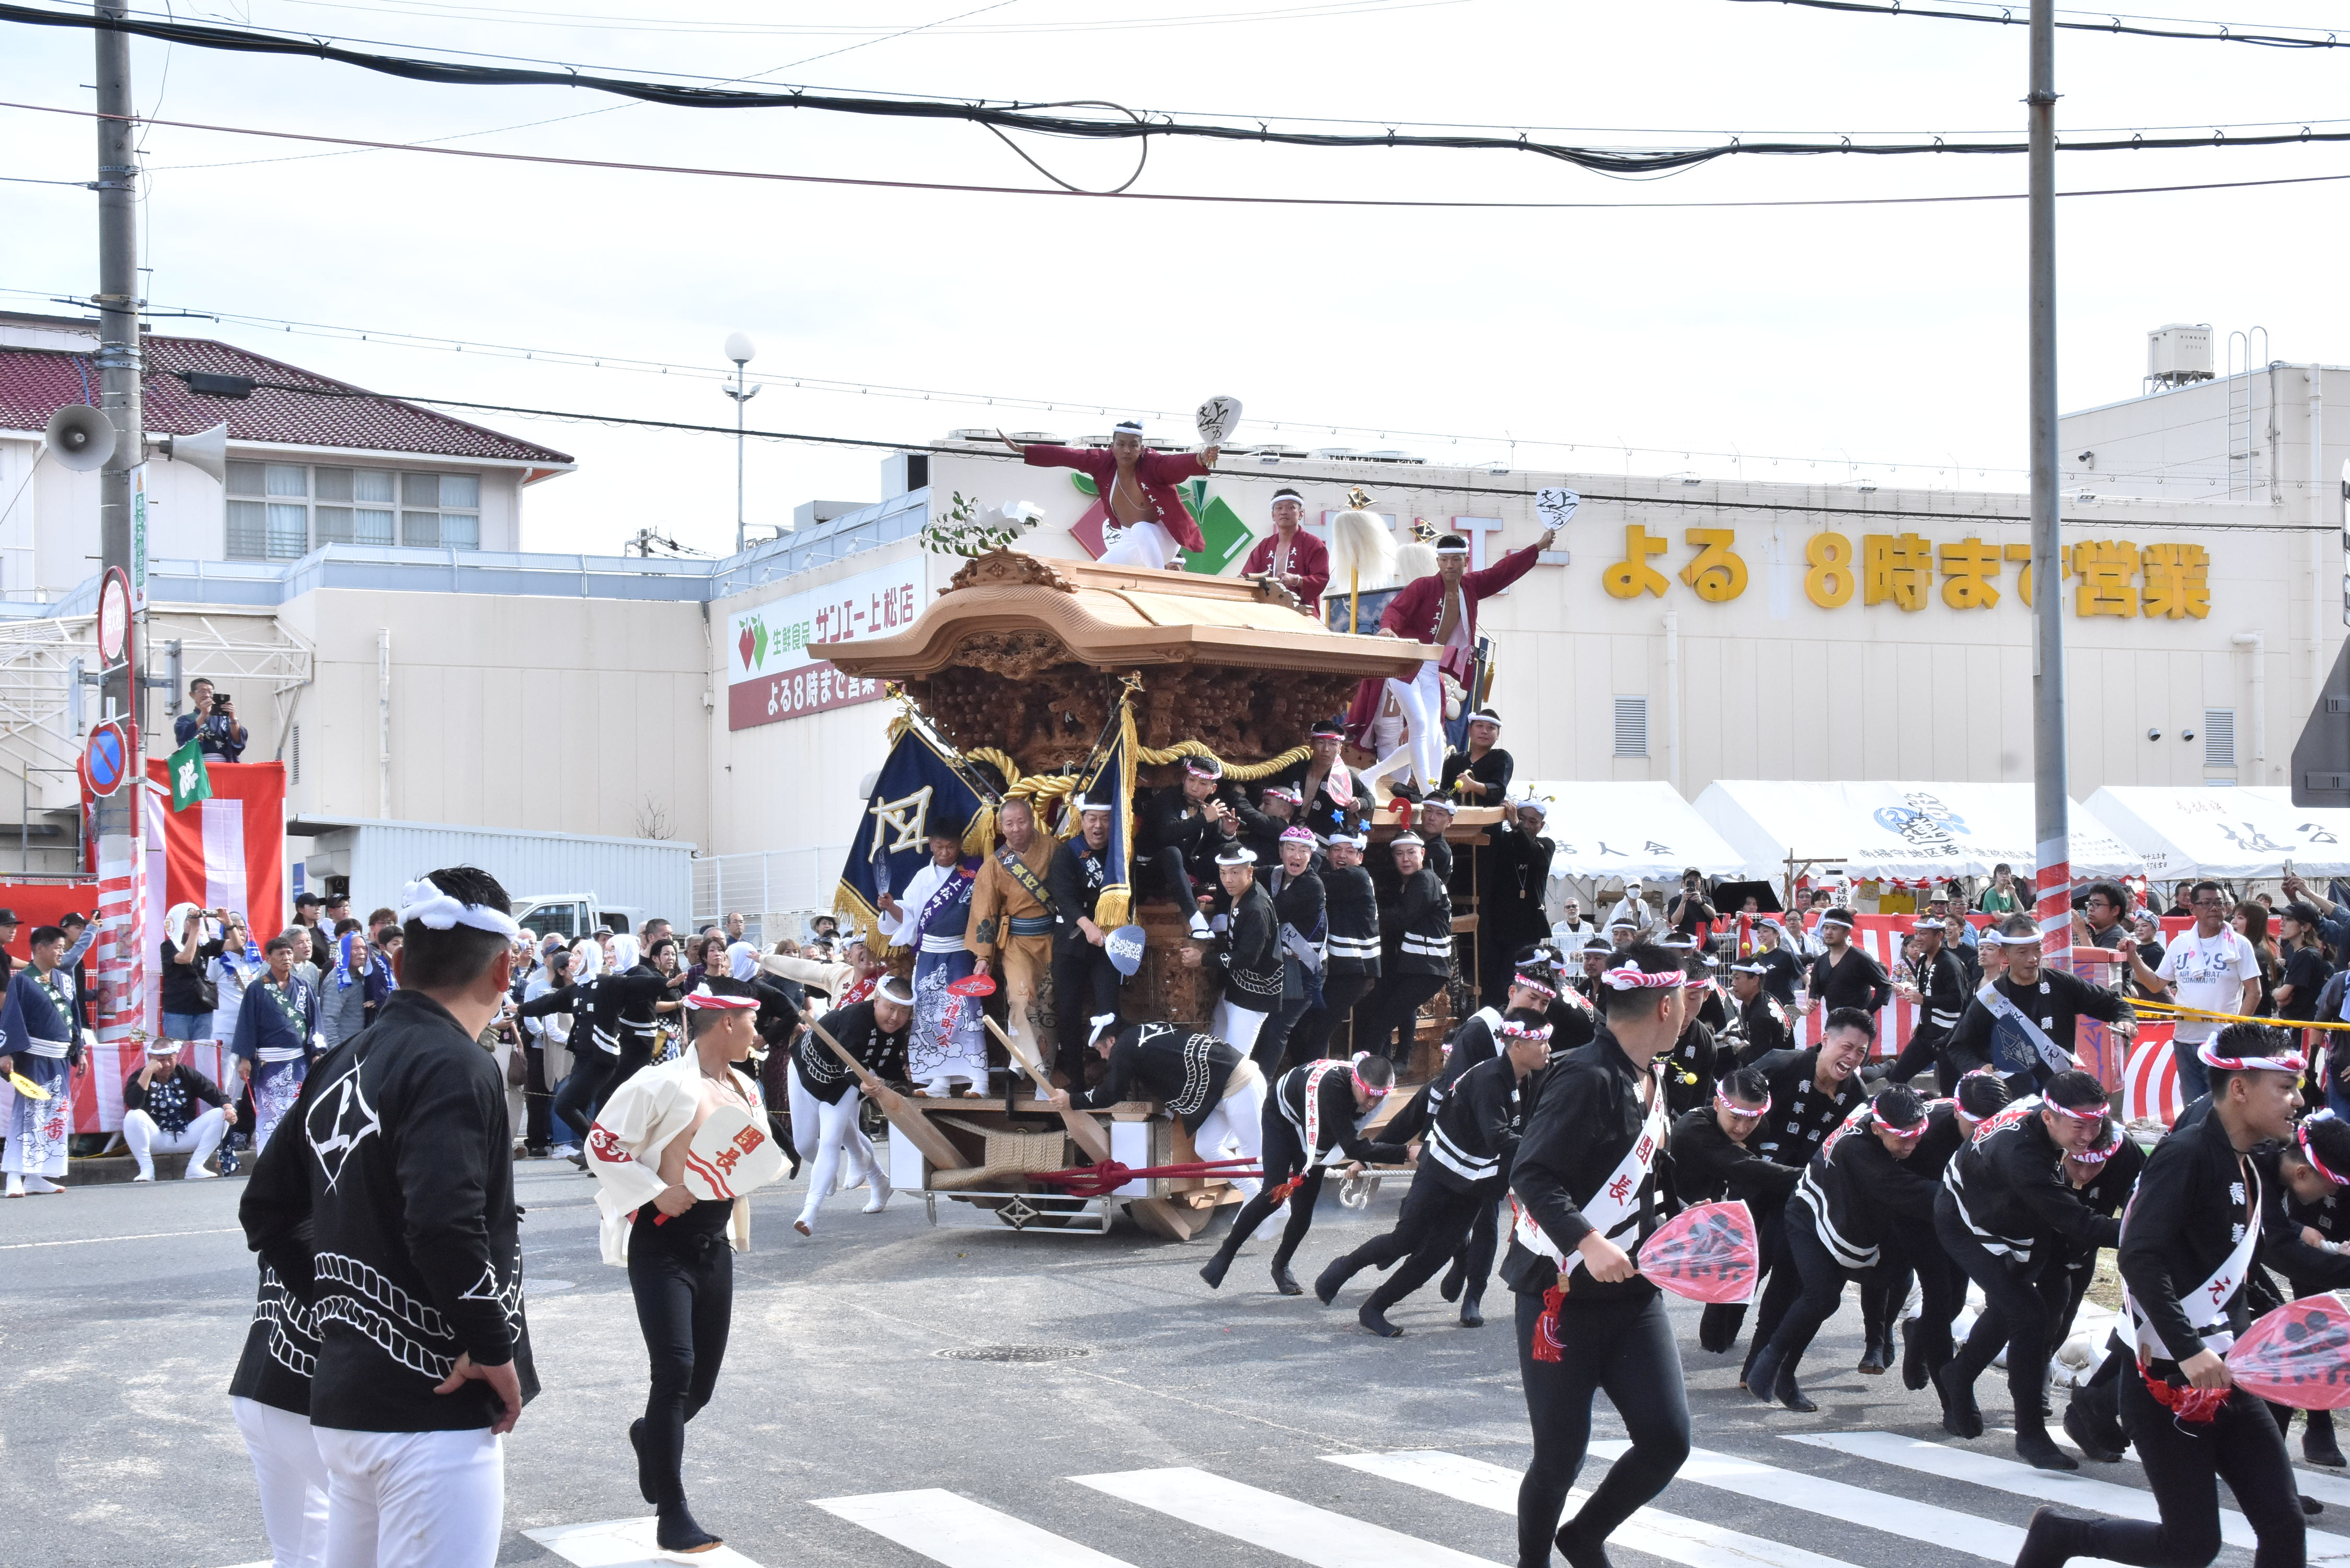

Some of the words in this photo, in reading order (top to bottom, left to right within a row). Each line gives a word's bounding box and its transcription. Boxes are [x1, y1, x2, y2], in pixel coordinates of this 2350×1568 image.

[1141, 481, 1165, 516] 大工方
[1287, 547, 1297, 569] 大工
[104, 602, 123, 637] 消火栓
[815, 583, 914, 644] サンエー上松店
[1429, 597, 1443, 635] 大工方
[773, 620, 810, 656] 生鮮食品
[1306, 1064, 1329, 1146] 上松町青年團
